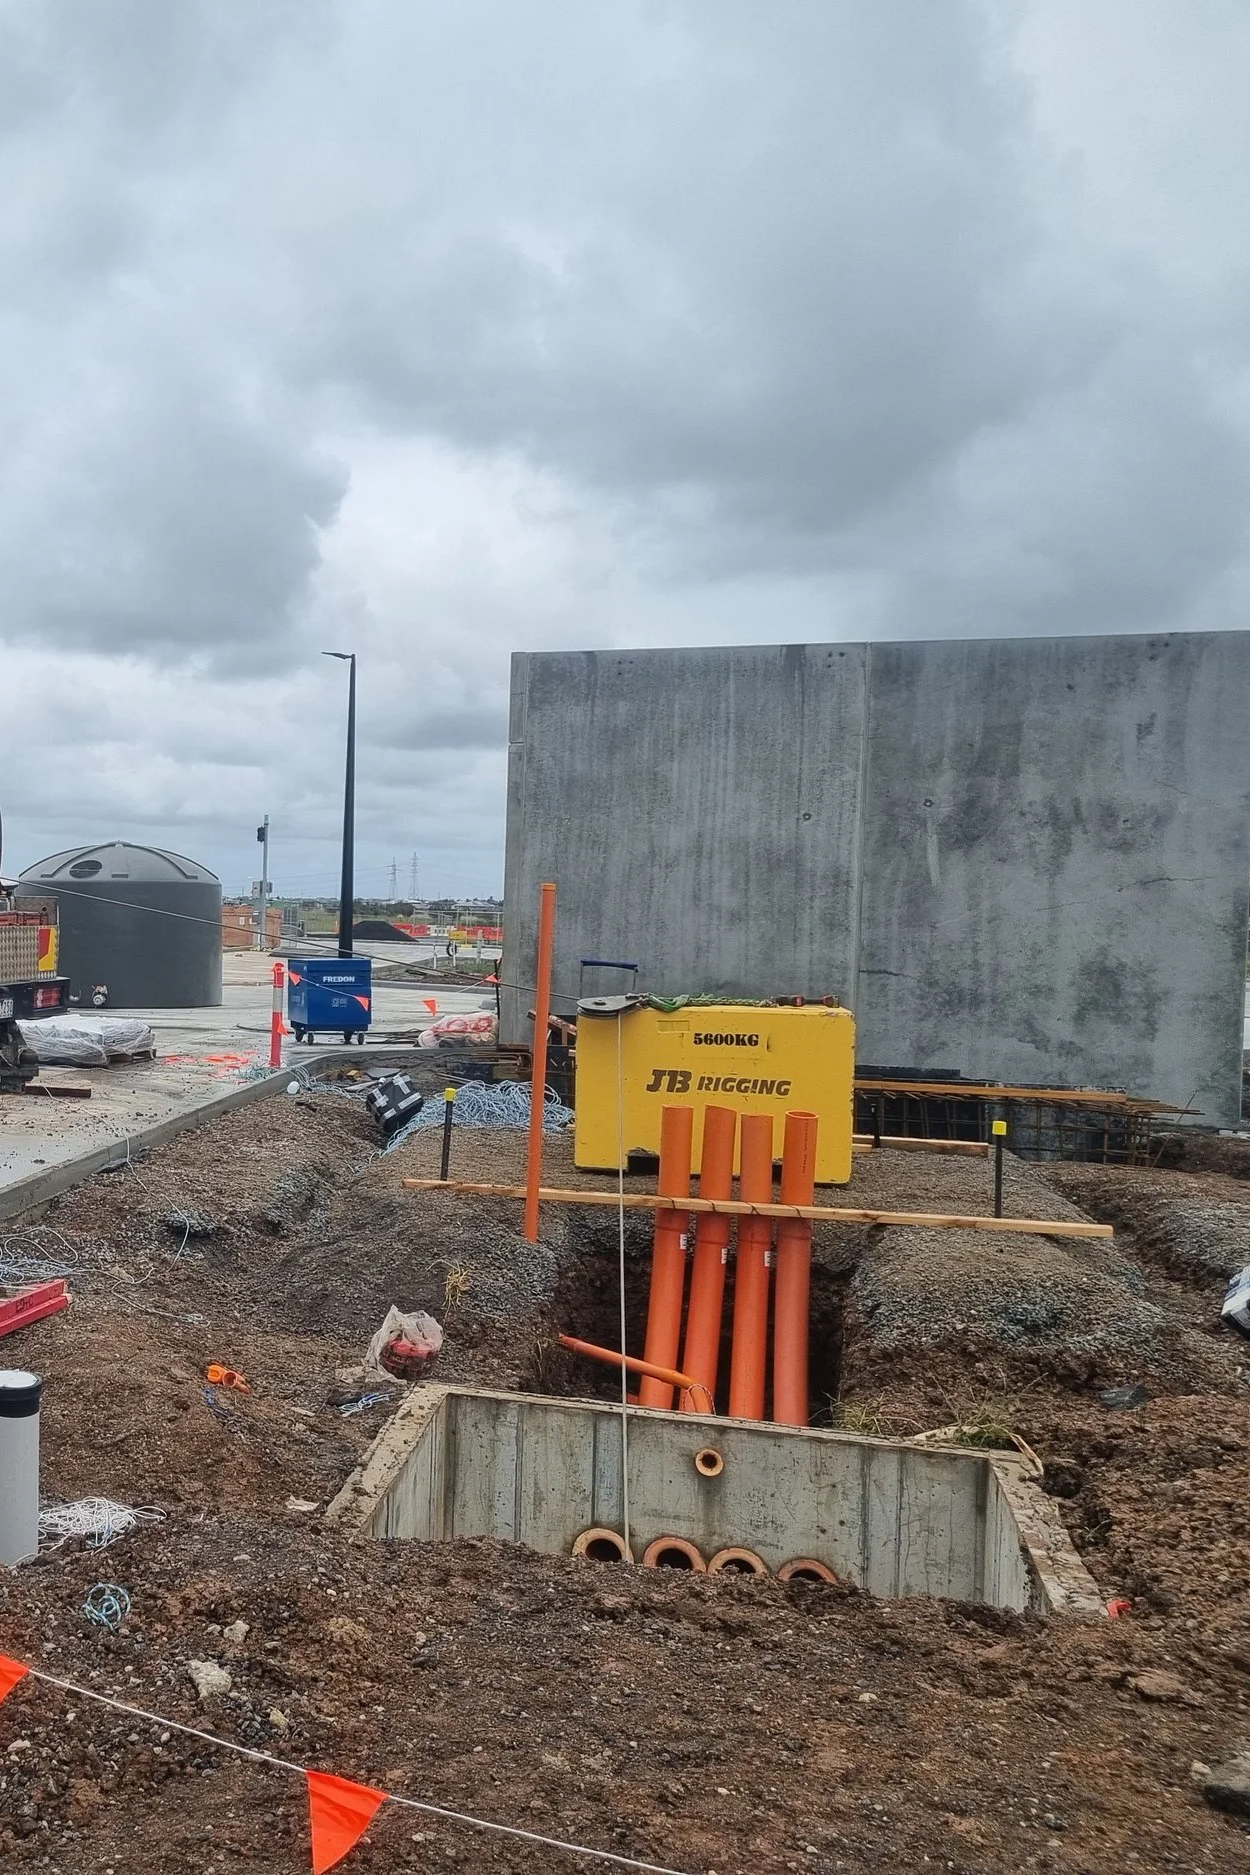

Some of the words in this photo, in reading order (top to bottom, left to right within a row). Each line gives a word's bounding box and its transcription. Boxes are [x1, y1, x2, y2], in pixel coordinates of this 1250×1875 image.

[322, 975, 355, 983] FREDON
[693, 1032, 759, 1046] 5600KG
[646, 1069, 693, 1094] JB
[697, 1076, 792, 1096] RIGGING
